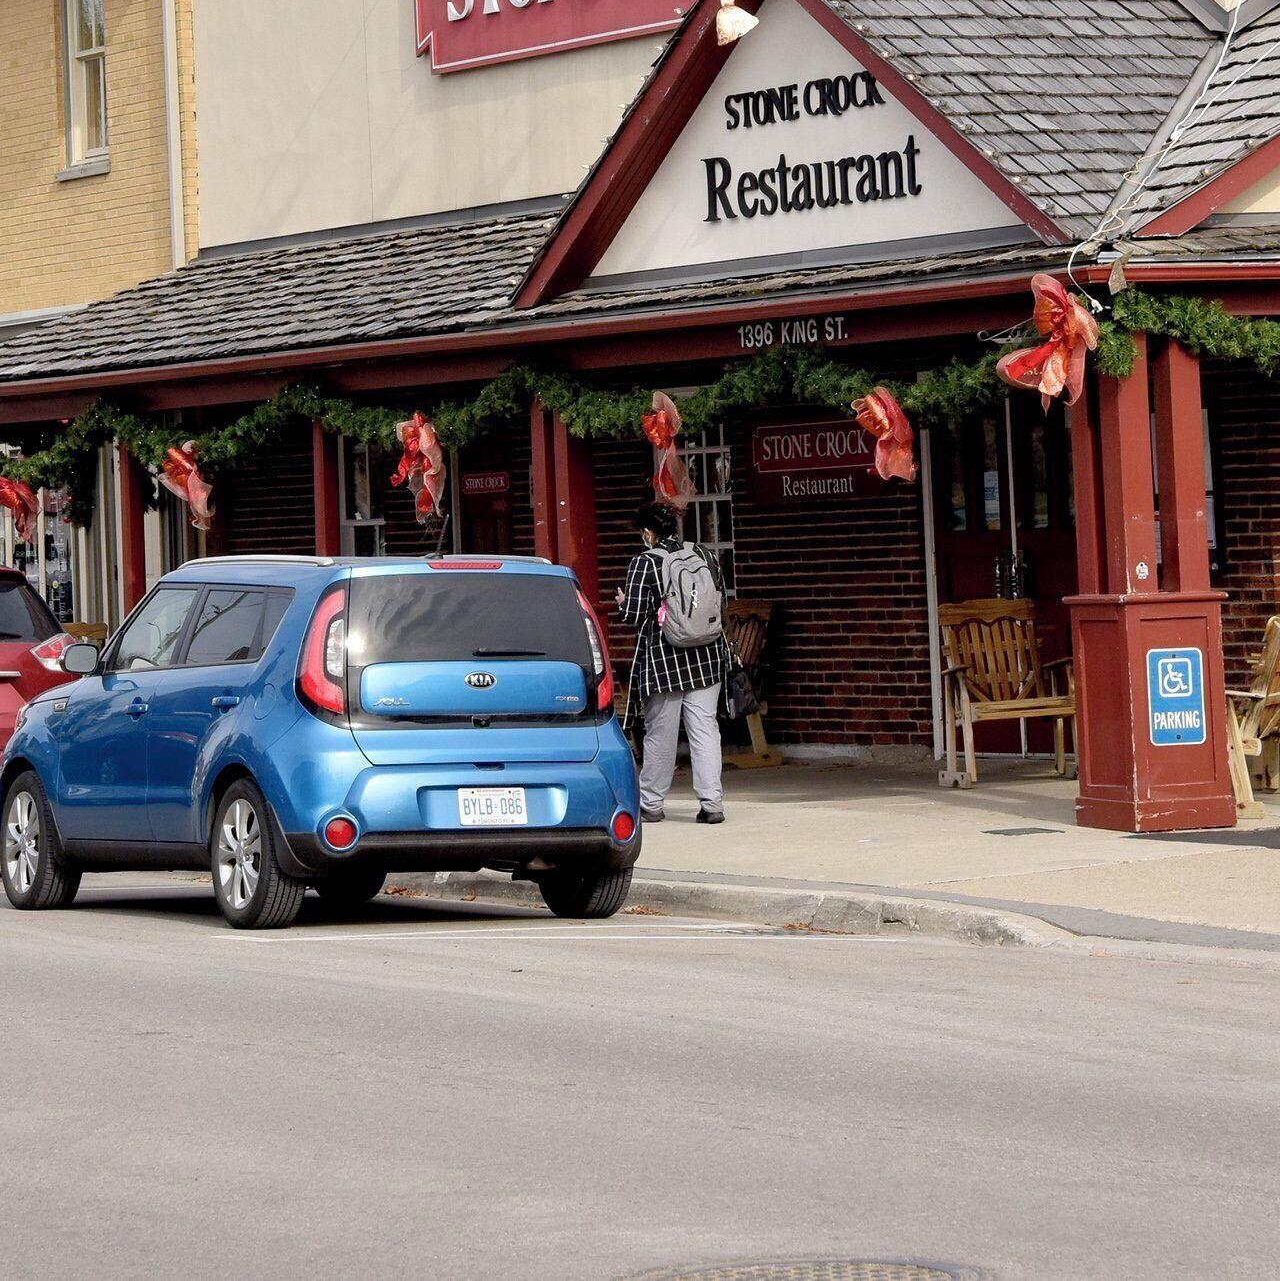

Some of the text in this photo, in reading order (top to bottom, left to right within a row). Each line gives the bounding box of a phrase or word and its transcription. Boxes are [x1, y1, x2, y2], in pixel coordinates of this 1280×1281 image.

[725, 70, 886, 130] STONE CROCK
[700, 134, 922, 222] Restaurant
[738, 317, 848, 348] 1396 KING ST.
[762, 428, 869, 460] STONE CROCK
[465, 476, 505, 489] STONE CROCK
[782, 475, 854, 497] Restaurant
[470, 674, 492, 686] KIA
[1154, 710, 1200, 730] PARKING
